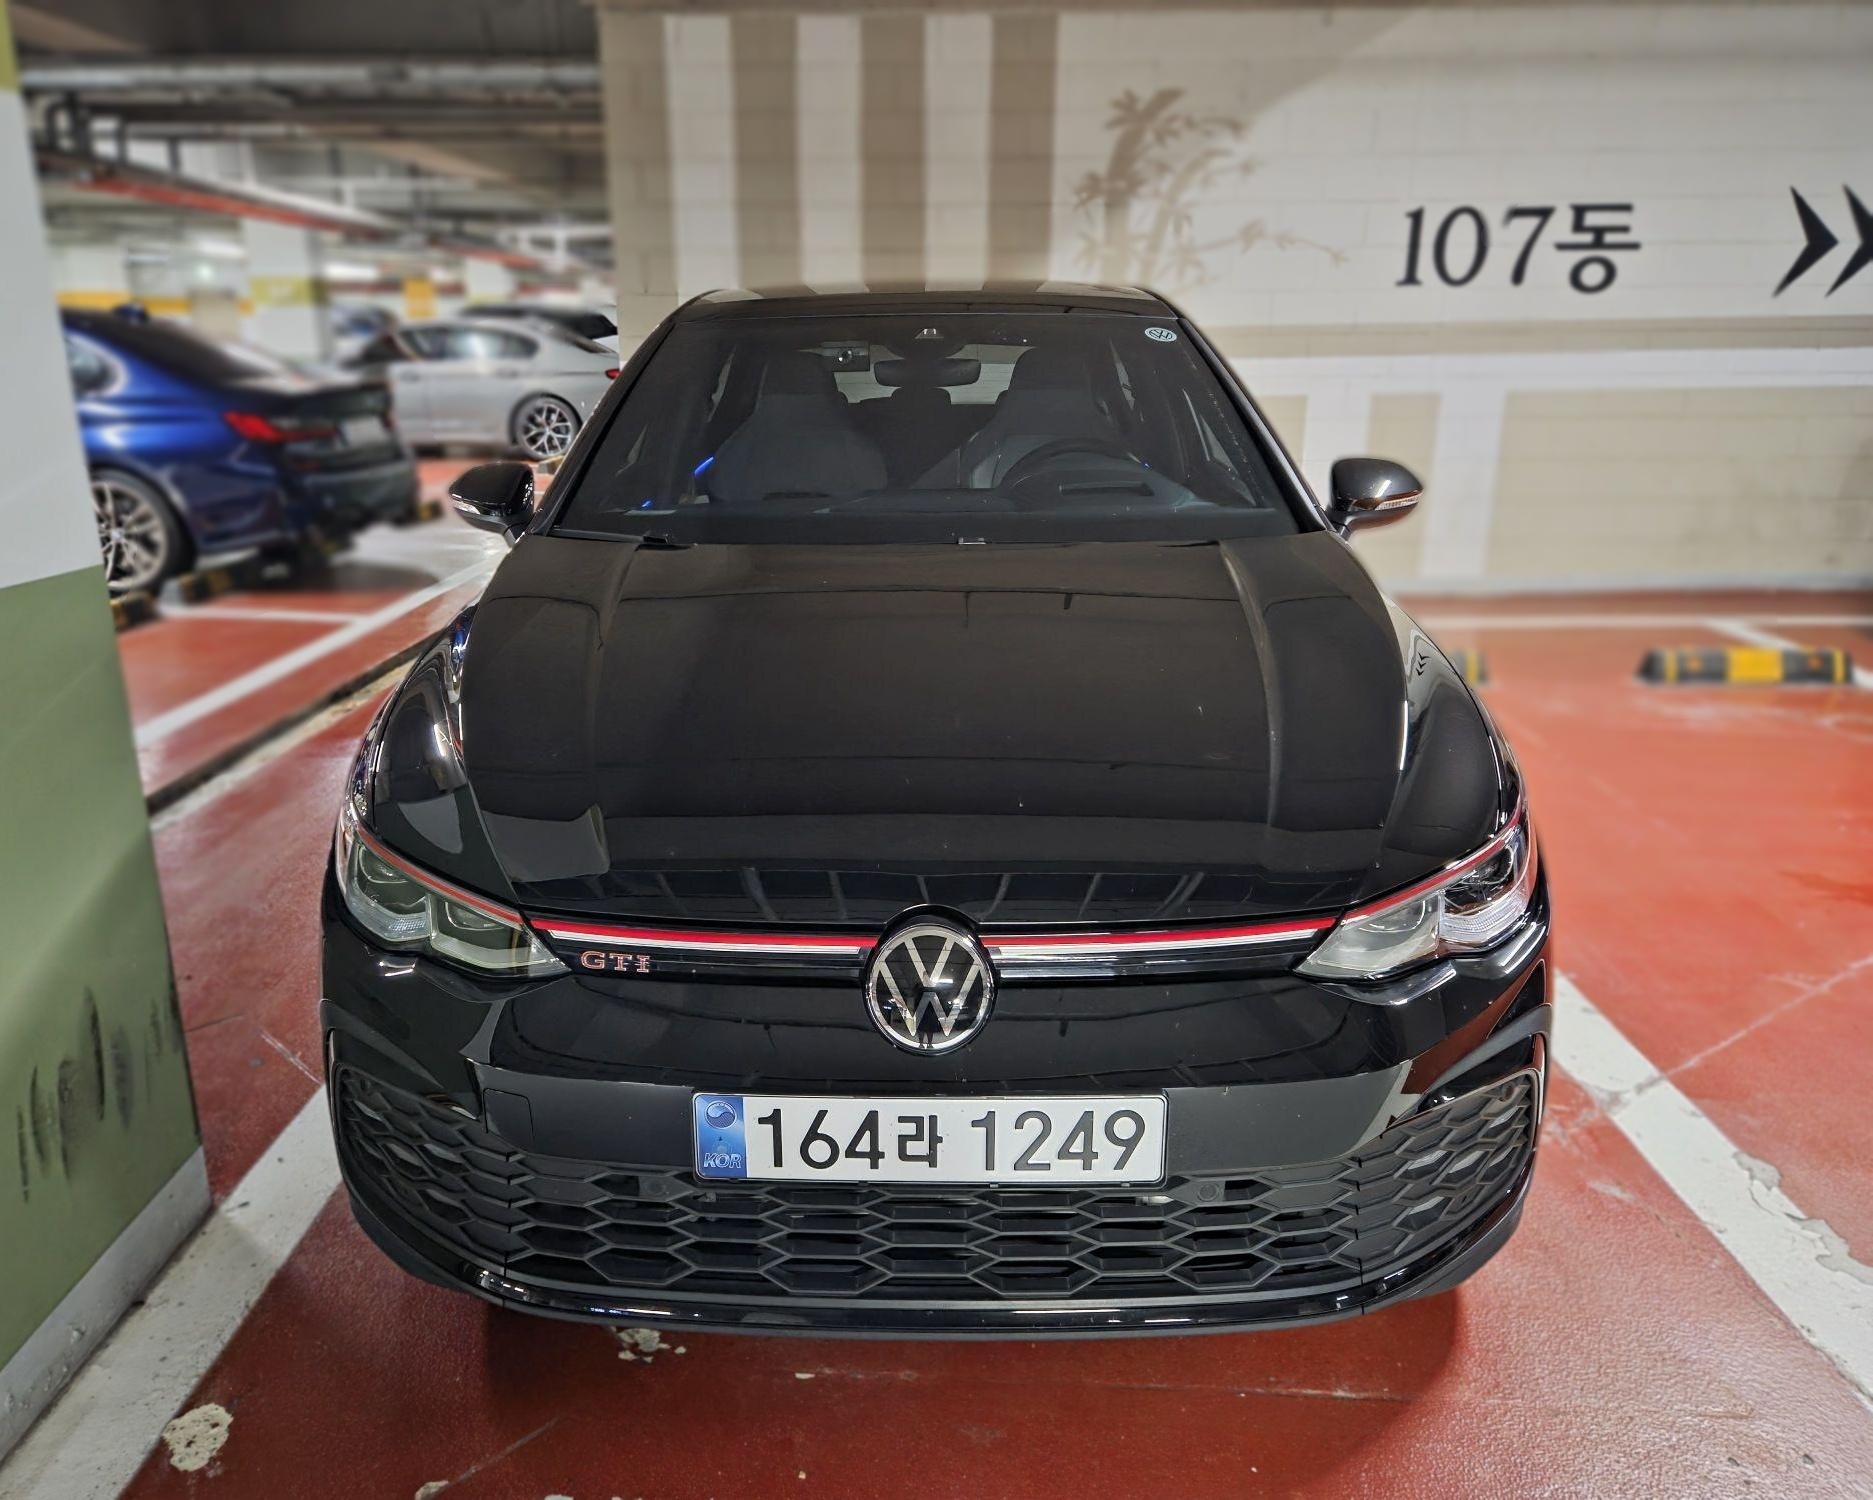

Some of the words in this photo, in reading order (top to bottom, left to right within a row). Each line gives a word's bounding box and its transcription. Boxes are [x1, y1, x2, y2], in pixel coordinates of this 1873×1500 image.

[1396, 203, 1642, 294] 107동
[580, 950, 650, 973] GTI
[703, 1152, 742, 1169] KOR
[757, 1108, 943, 1170] 164라
[971, 1110, 1146, 1171] 1249
